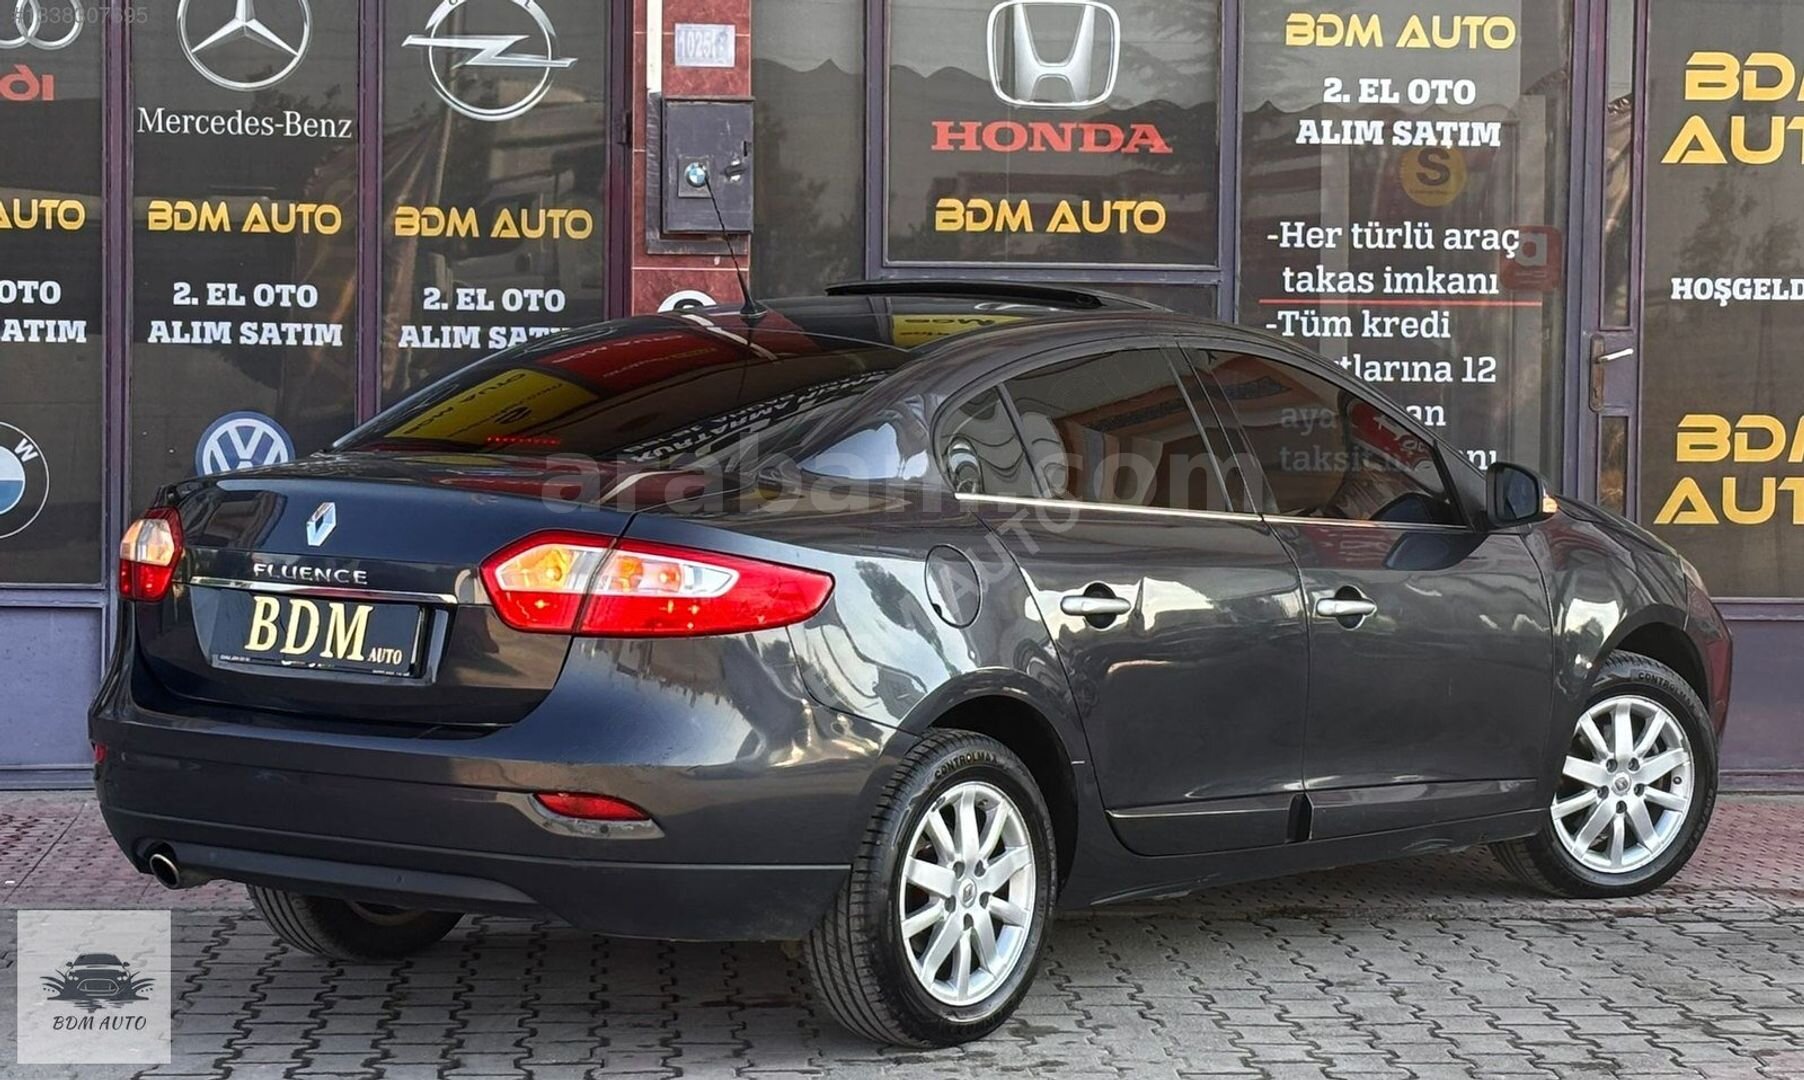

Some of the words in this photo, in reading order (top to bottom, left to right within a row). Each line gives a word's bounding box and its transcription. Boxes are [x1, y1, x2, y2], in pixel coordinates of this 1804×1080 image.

[1285, 12, 1384, 47] BDM
[1395, 14, 1517, 49] AUTO
[1685, 51, 1804, 101] BD
[1322, 77, 1350, 103] 2.
[1358, 78, 1400, 103] EL
[1407, 79, 1477, 104] OTO
[137, 107, 353, 138] Mercedes-Benz
[1295, 119, 1384, 145] ALIM
[1392, 121, 1501, 147] SATIM
[931, 121, 1173, 154] HONDA
[148, 200, 231, 231] BDM
[241, 202, 342, 235] AUTO
[394, 206, 480, 237] BDM
[490, 208, 593, 240] AUTO
[935, 198, 1033, 232] BDM
[1046, 199, 1166, 234] AUTO
[1267, 222, 1342, 248] -Her
[1351, 222, 1435, 250] türlü
[1444, 228, 1520, 258] araç
[0, 280, 61, 304] OTO
[1282, 265, 1374, 294] takas
[1383, 266, 1499, 294] imkanı
[173, 281, 198, 306] 2.
[206, 282, 246, 306] EL
[253, 283, 318, 308] OTO
[423, 287, 448, 310] 2.
[456, 288, 494, 311] EL
[502, 288, 566, 312] OTO
[1, 319, 87, 343] ATIM
[147, 320, 232, 344] ALIM
[239, 322, 343, 346] SATIM
[398, 325, 481, 349] ALIM
[1266, 311, 1352, 337] -Tüm
[1361, 311, 1451, 338] kredi
[1334, 354, 1453, 382] tlarına
[1461, 356, 1496, 383] 12
[253, 563, 368, 585] FLUENCE
[245, 596, 374, 661] BDM
[367, 647, 403, 665] AUTO
